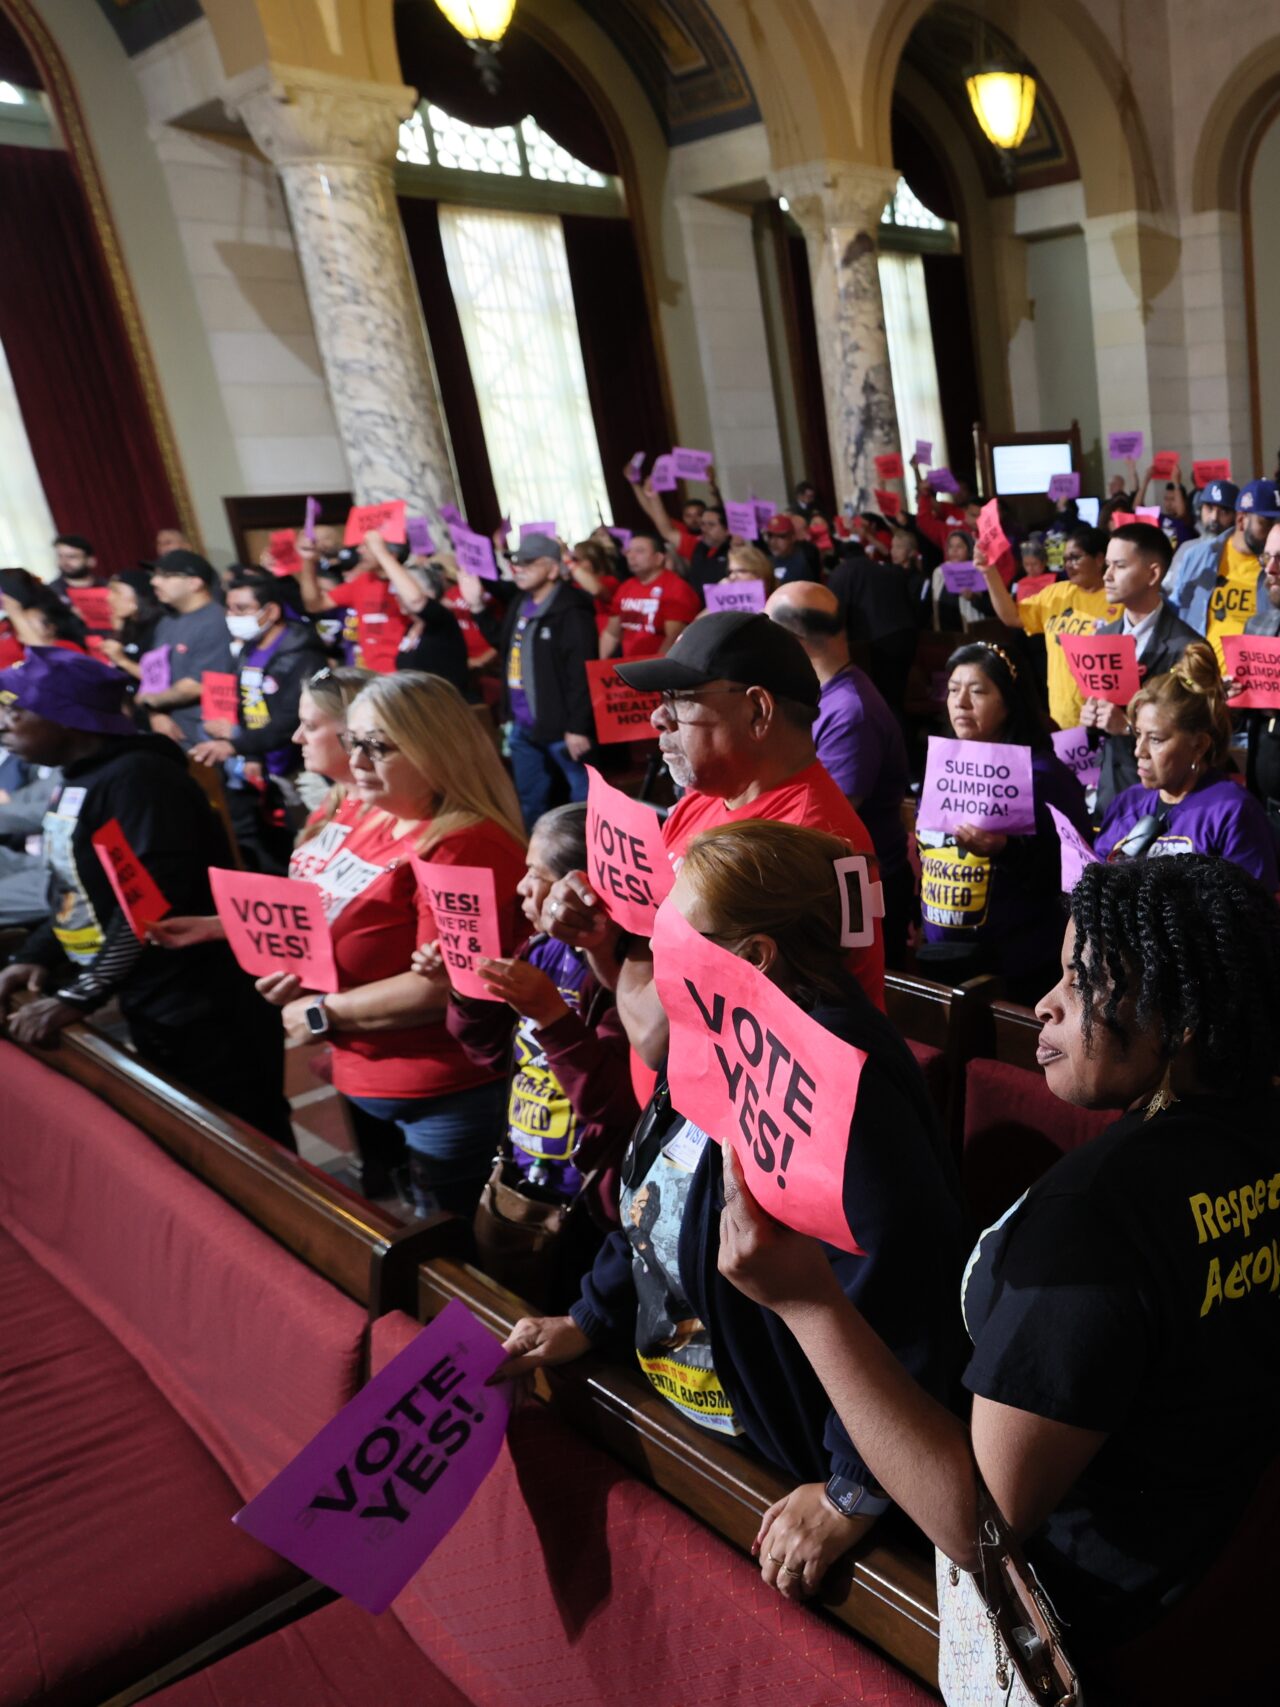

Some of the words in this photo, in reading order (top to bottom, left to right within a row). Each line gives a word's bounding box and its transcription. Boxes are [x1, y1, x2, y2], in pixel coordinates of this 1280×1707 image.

[714, 594, 755, 606] VOTE
[1072, 653, 1123, 671] VOTE
[1081, 673, 1120, 690] YES!
[944, 760, 1010, 780] SUELDO
[936, 778, 1019, 799] OLIMPICO
[940, 797, 1010, 817] AHORA!
[592, 806, 653, 874] VOTE
[594, 855, 660, 910] YES!
[431, 889, 480, 913] YES!
[230, 897, 312, 931] VOTE
[246, 929, 312, 961] YES!
[468, 936, 482, 953] &
[683, 976, 817, 1137] VOTE
[713, 1042, 795, 1190] YES!
[680, 1385, 733, 1409] RACISM
[309, 1356, 467, 1513] VOTE
[358, 1395, 485, 1524] YES!
